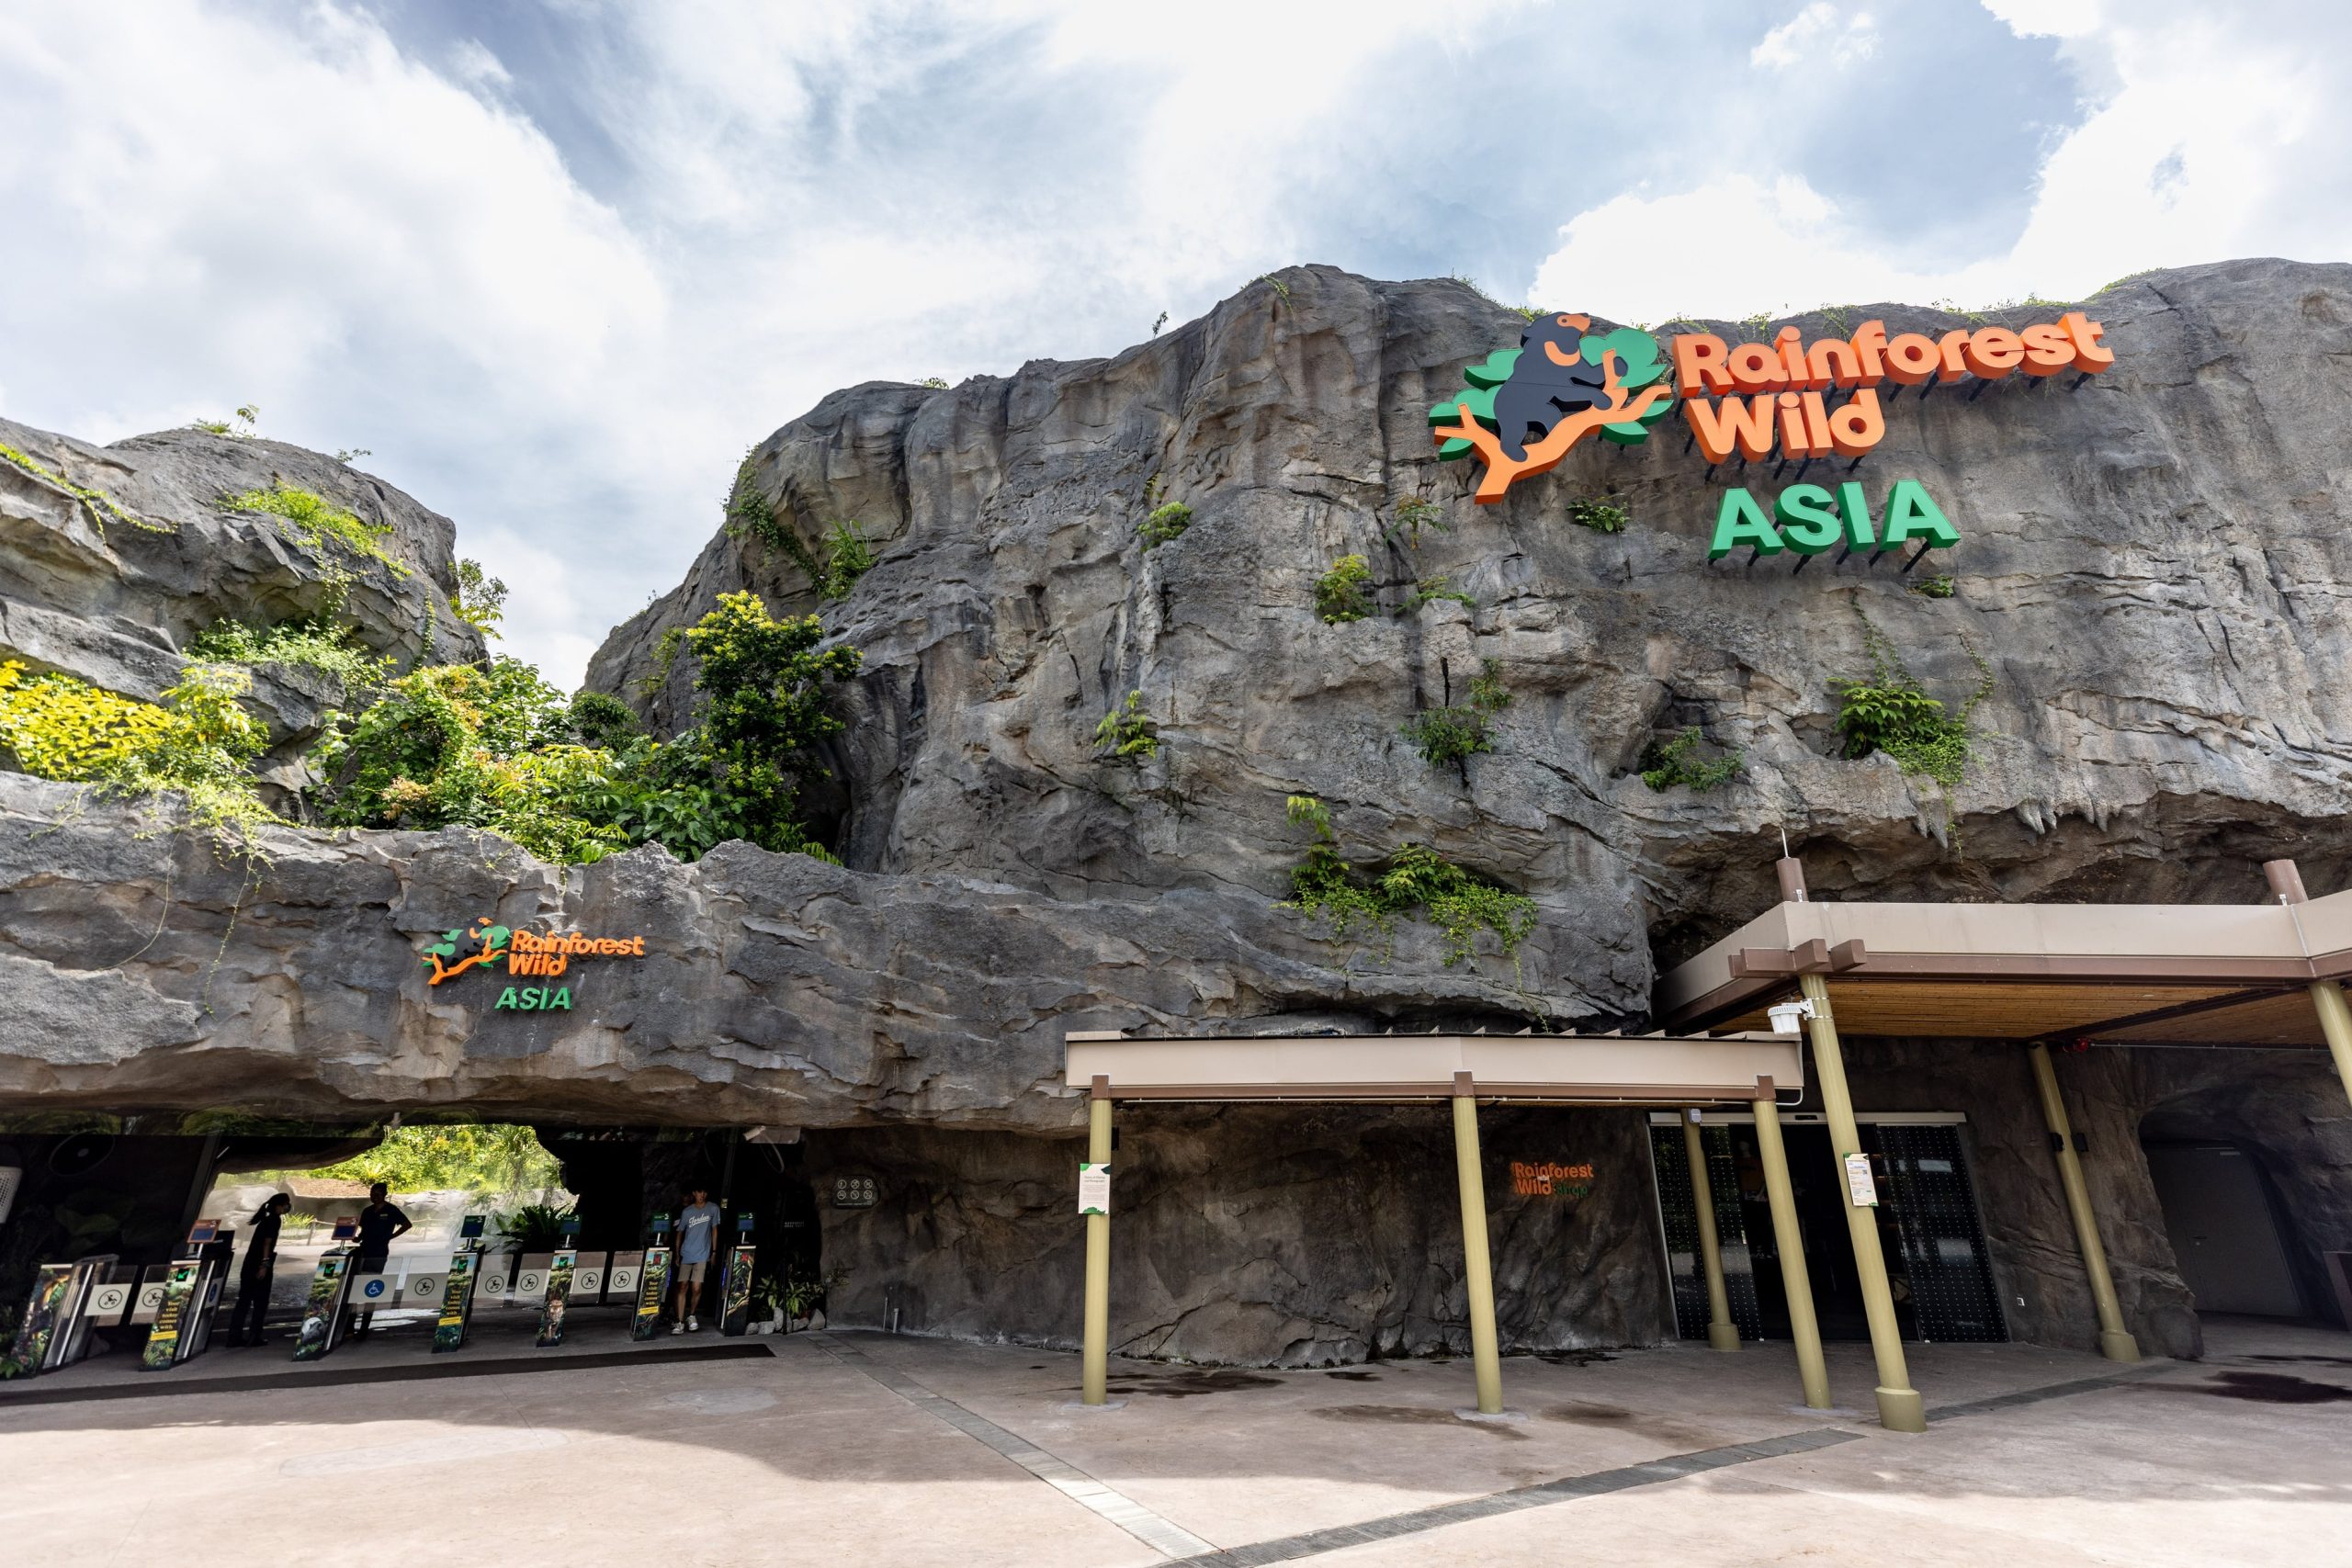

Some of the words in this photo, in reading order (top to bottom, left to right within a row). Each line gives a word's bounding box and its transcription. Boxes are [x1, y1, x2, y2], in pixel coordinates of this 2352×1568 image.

[1672, 312, 2114, 398] Rainforest
[1684, 388, 1885, 464] Wild
[1708, 479, 1961, 558] ASIA
[511, 930, 645, 956] Rainforest
[509, 953, 568, 976] Wild
[494, 987, 572, 1010] ASIA
[1513, 1161, 1594, 1179] Rainforest
[1516, 1179, 1552, 1195] Wild
